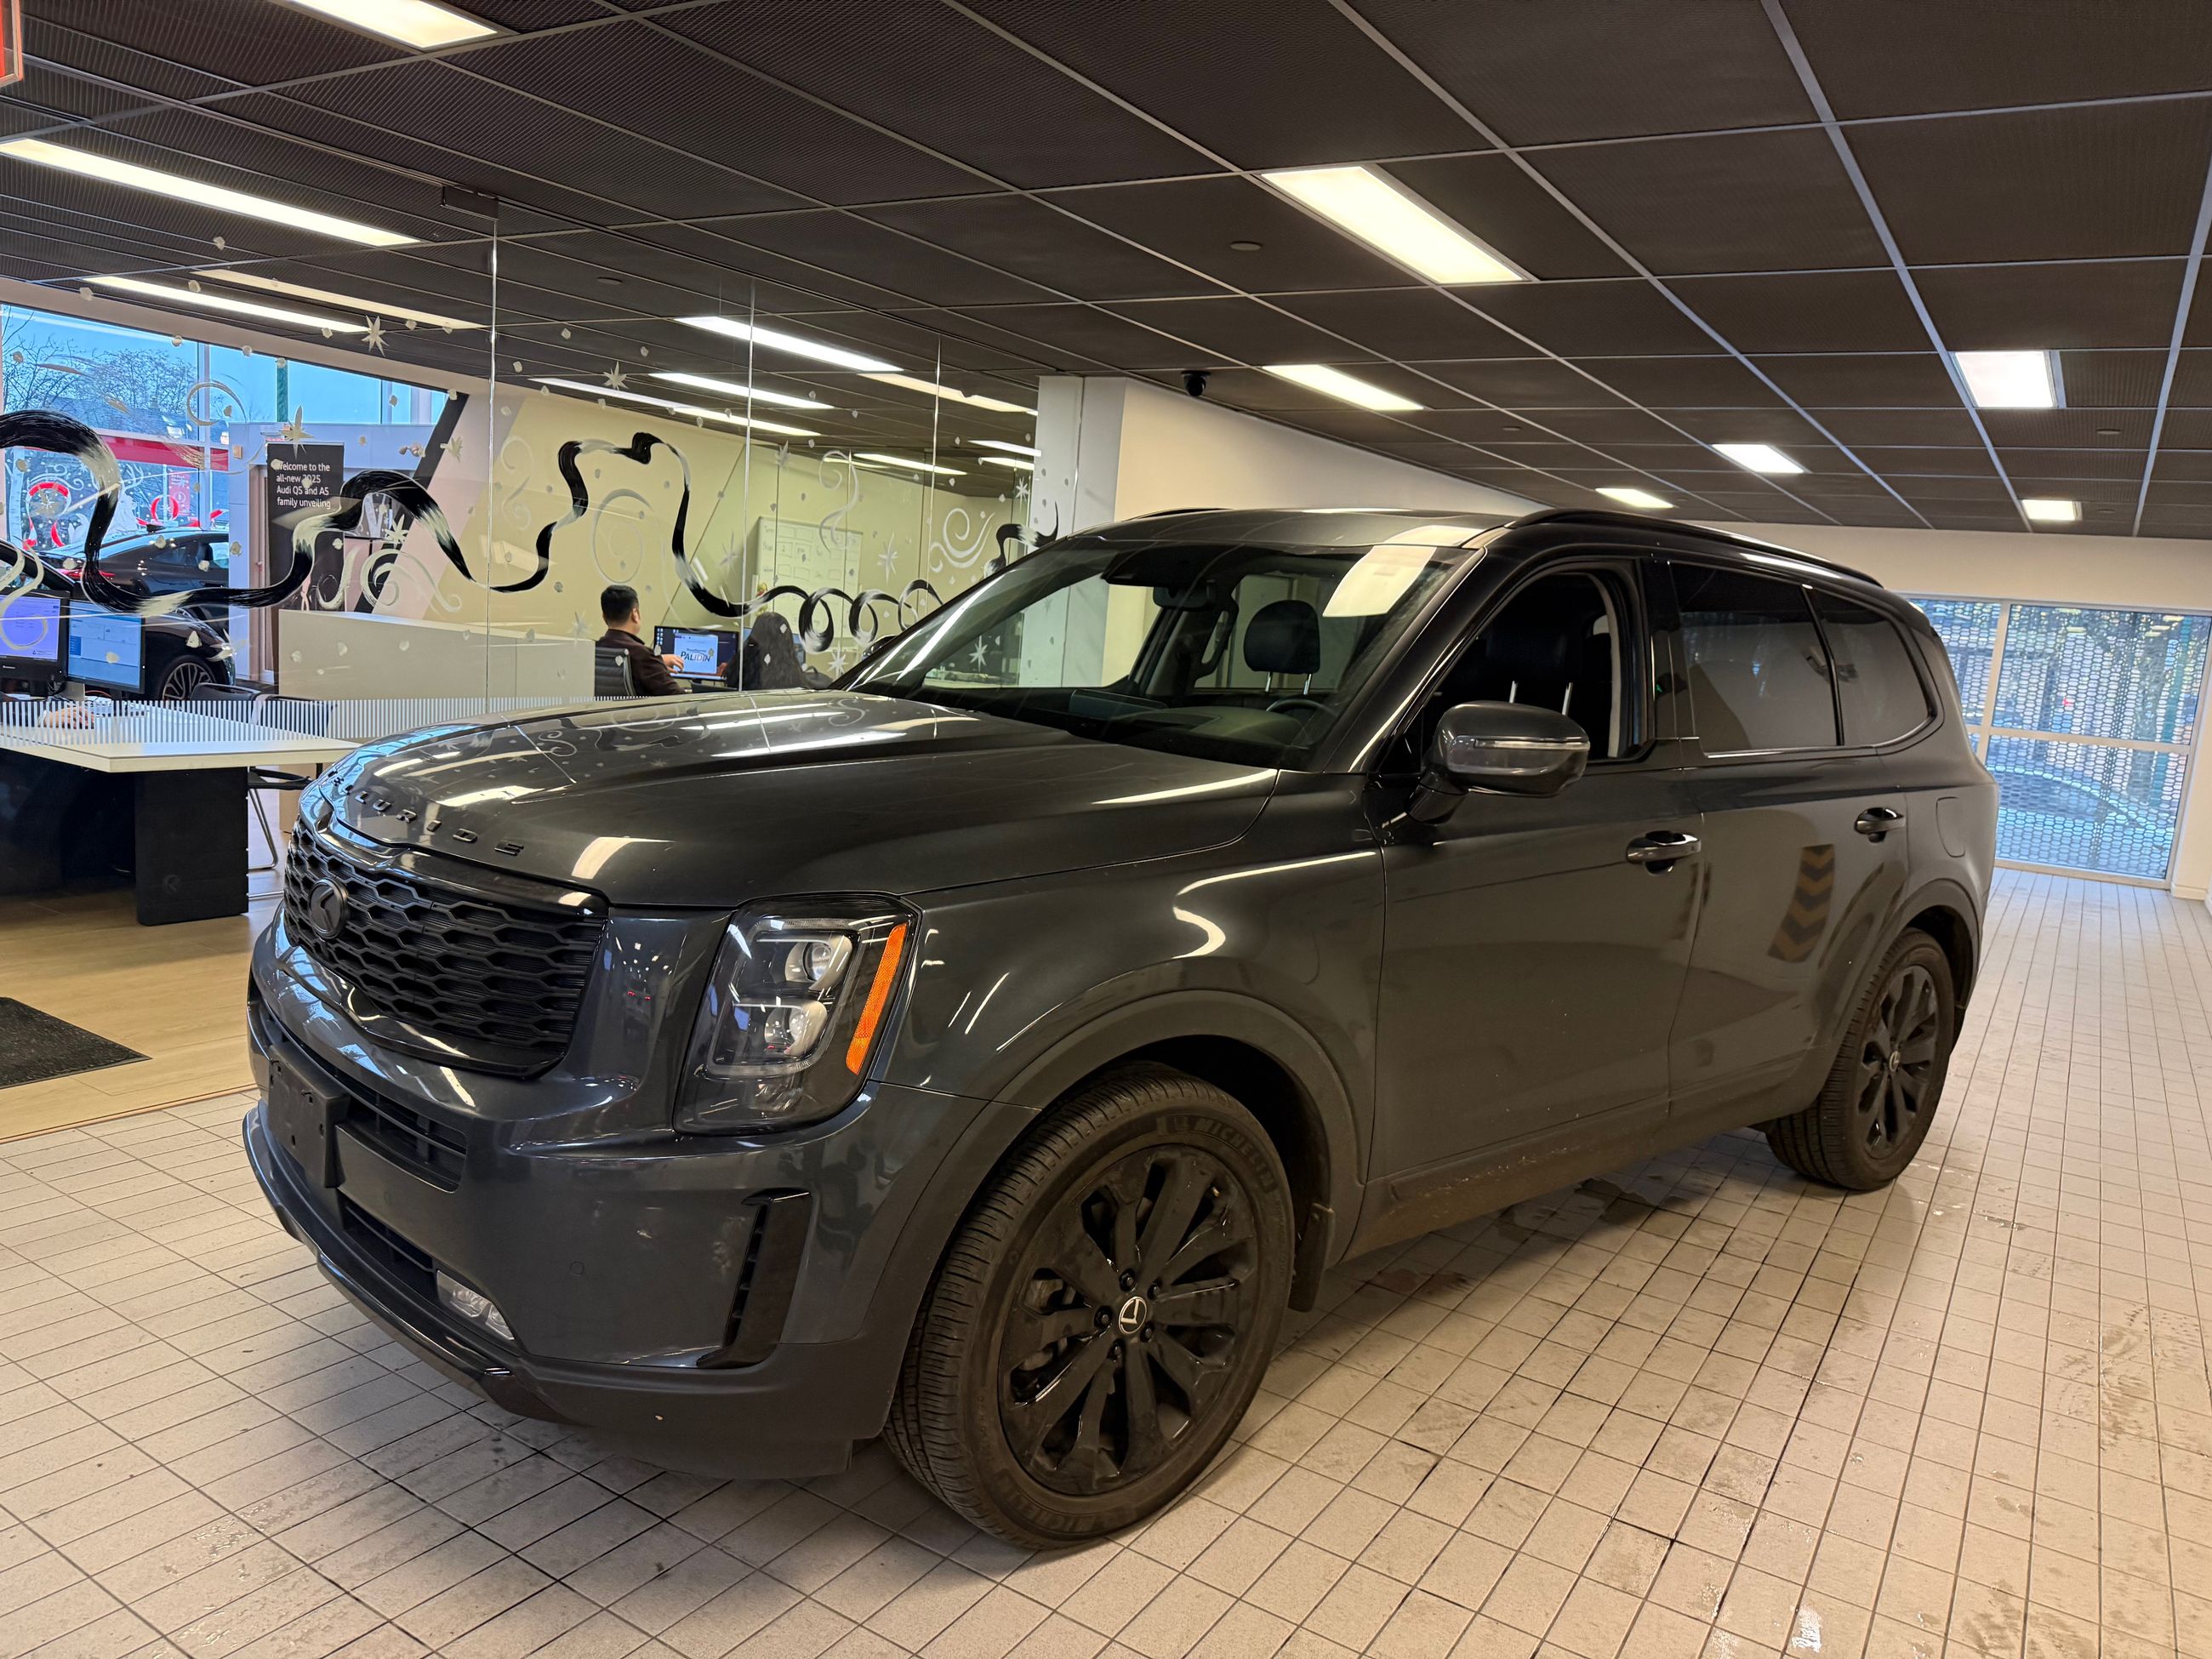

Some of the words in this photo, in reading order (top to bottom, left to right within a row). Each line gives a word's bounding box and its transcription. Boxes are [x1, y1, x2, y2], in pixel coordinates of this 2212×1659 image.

[274, 462, 307, 471] elcome
[318, 463, 331, 472] the
[276, 474, 301, 483] all-new
[276, 486, 292, 494] Audi
[293, 486, 303, 495] Q5
[305, 487, 318, 495] and
[319, 487, 329, 496] A5
[276, 497, 298, 509] family
[299, 499, 331, 510] unveiling
